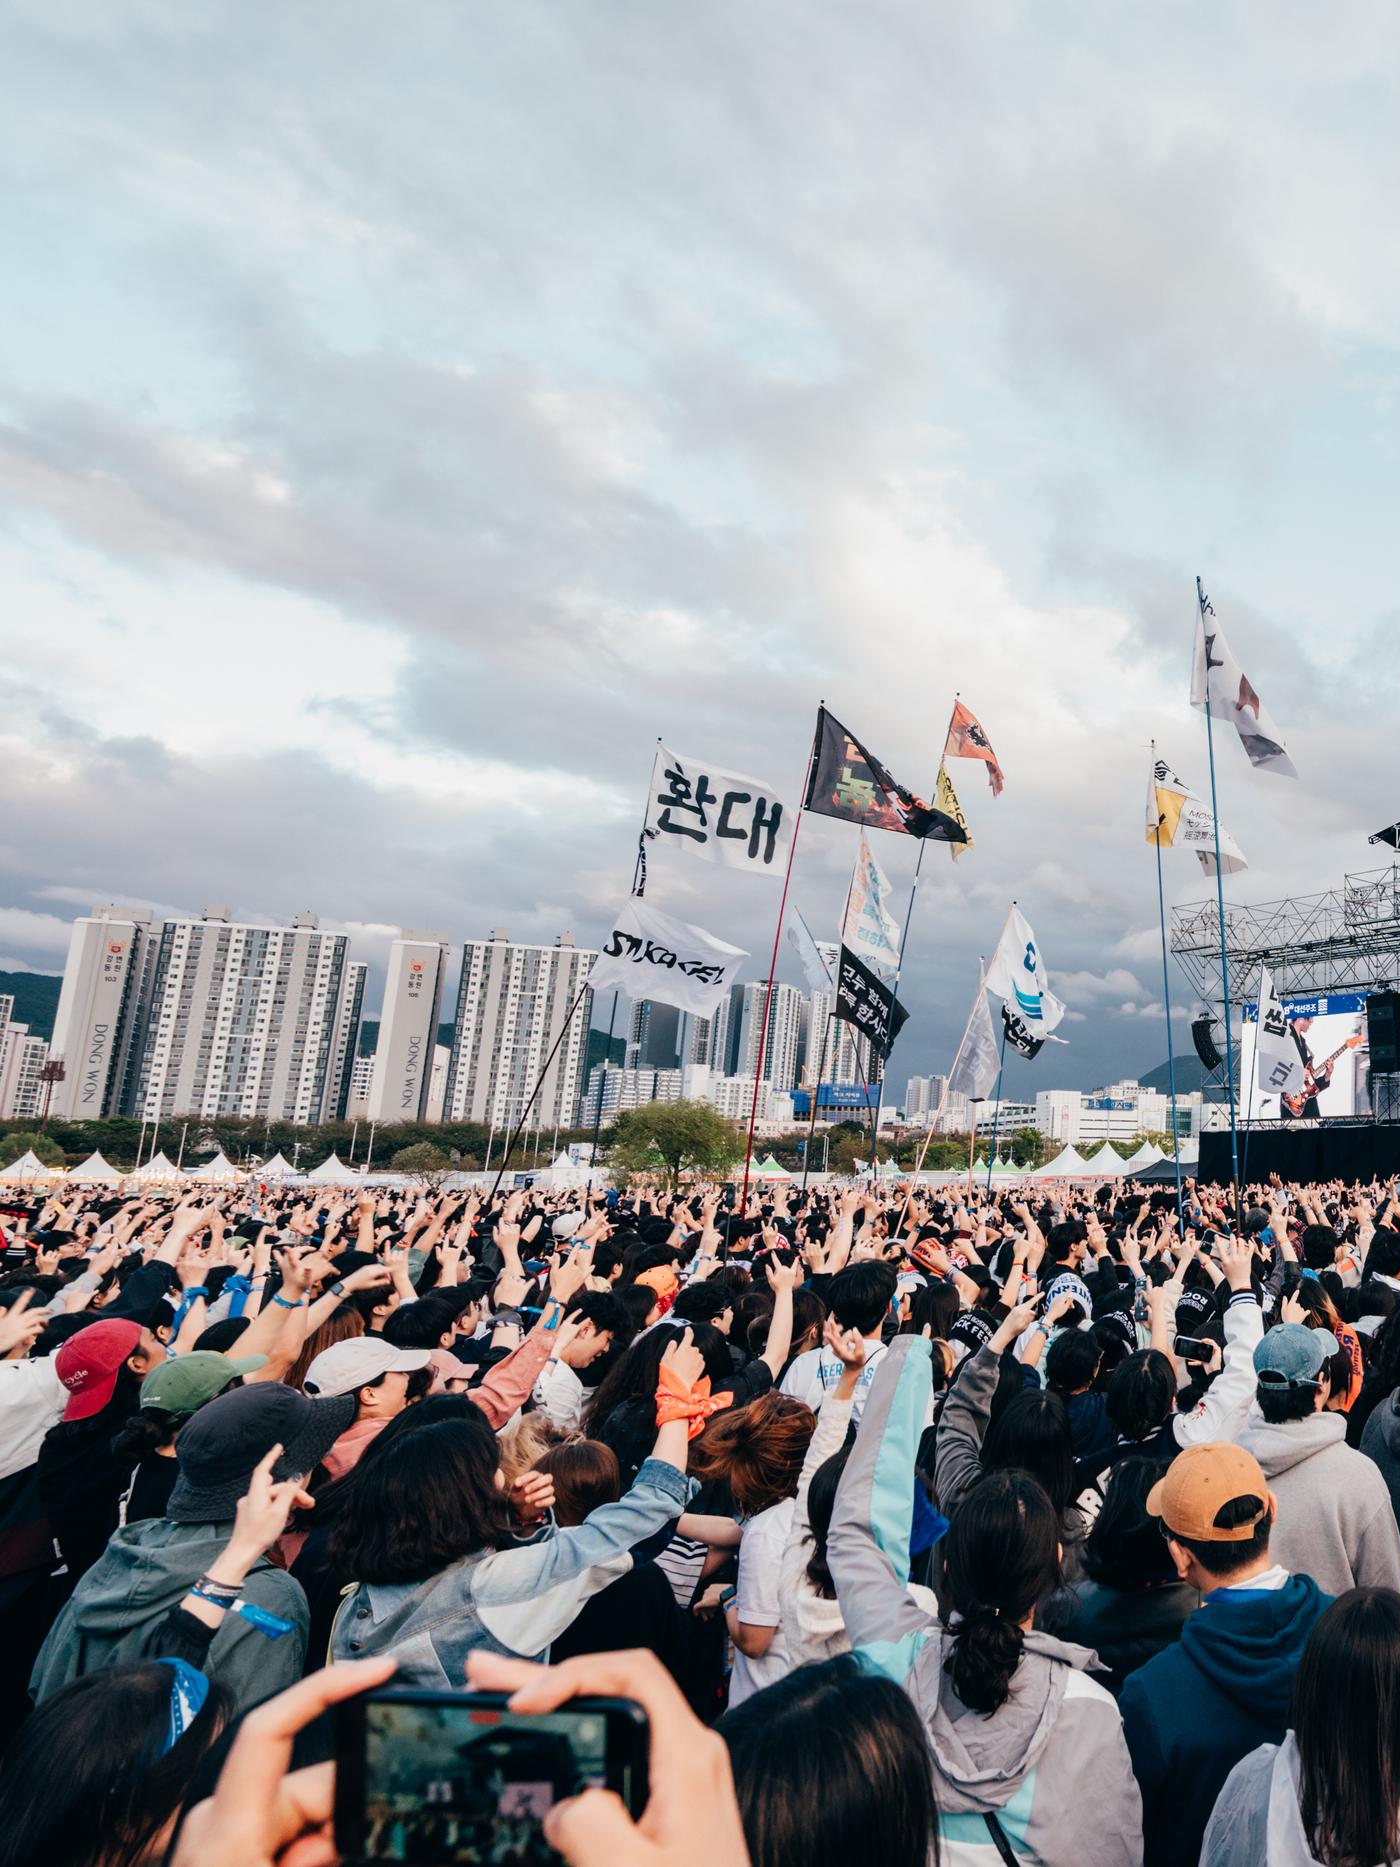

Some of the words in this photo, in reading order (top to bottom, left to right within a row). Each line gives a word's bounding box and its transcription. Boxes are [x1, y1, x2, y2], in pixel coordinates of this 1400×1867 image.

[657, 762, 783, 864] 환대
[89, 1023, 109, 1065] DONG
[406, 1036, 422, 1073] DONG
[82, 1070, 101, 1104] WON
[401, 1078, 416, 1108] WON
